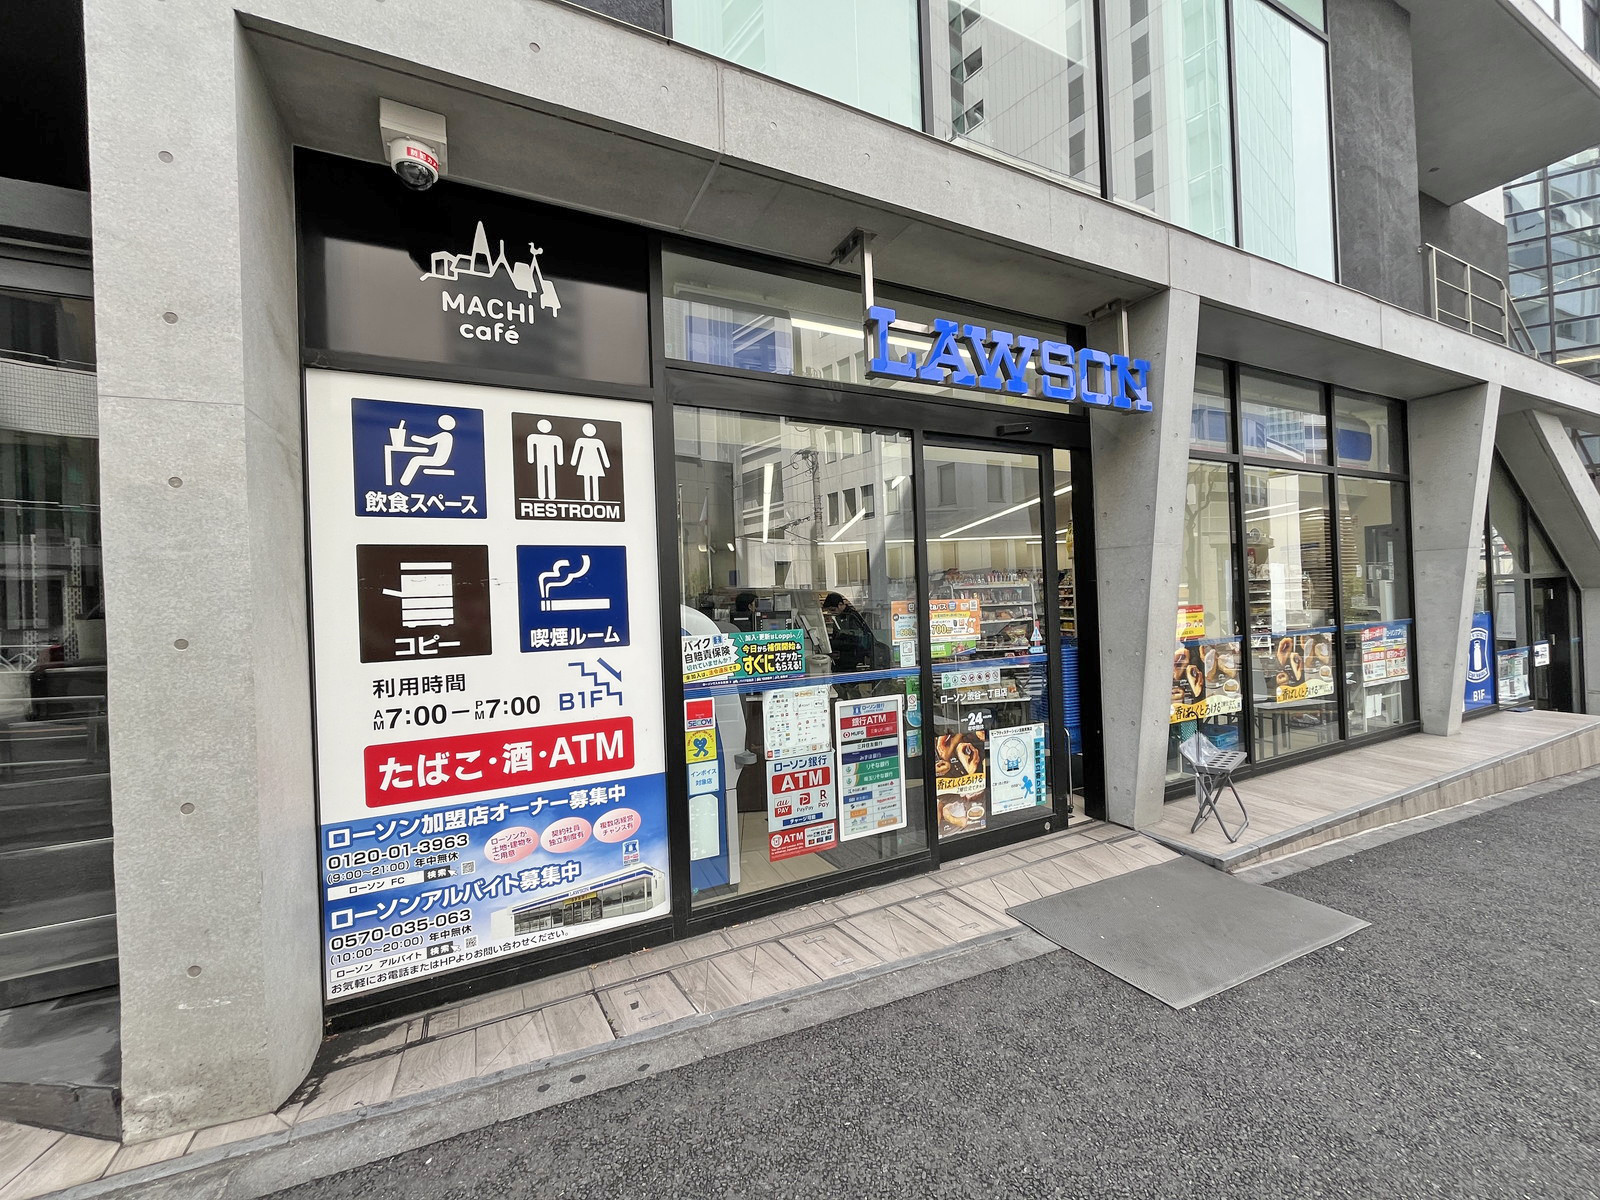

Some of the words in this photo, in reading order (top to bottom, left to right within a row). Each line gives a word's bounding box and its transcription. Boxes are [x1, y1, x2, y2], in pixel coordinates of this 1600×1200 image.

[442, 290, 535, 325] MACHI
[459, 322, 520, 345] café
[866, 305, 1153, 413] LAWSON
[365, 491, 478, 515] 飲食スペース
[520, 502, 620, 519] RESTROOM
[395, 633, 461, 656] コピー
[530, 626, 620, 649] 喫煙ルーム
[684, 638, 710, 652] バイク
[685, 646, 730, 664] 自賠責保険
[743, 654, 775, 674] すぐに
[775, 652, 802, 662] ステッカー
[372, 674, 466, 699] 利用時間
[1473, 689, 1486, 701] B1F
[559, 689, 604, 711] B1F
[688, 718, 712, 728] SECOM
[852, 714, 887, 727] 銀行ATM
[968, 712, 983, 726] 24
[691, 768, 717, 778] インボイス
[774, 754, 827, 773] ローソン銀行
[781, 769, 823, 792] ATM
[328, 784, 626, 849] ローソン加盟店オーナー募集中
[490, 830, 528, 845] ローソンが
[783, 831, 804, 844] ATM
[328, 834, 468, 870] 0120-01-3963
[415, 852, 459, 867] 年中無休
[349, 881, 385, 894] ローソン
[391, 877, 405, 885] FC
[427, 868, 448, 879] 検索
[331, 862, 580, 930] ローソンアルバイト募集中
[331, 909, 471, 951] 0570-035-063
[429, 925, 472, 942] 年中無休
[331, 929, 569, 994] お気軽にお電話またはHPよりお問い合わせください。
[336, 963, 373, 978] ローソン
[379, 951, 423, 968] アルバイト
